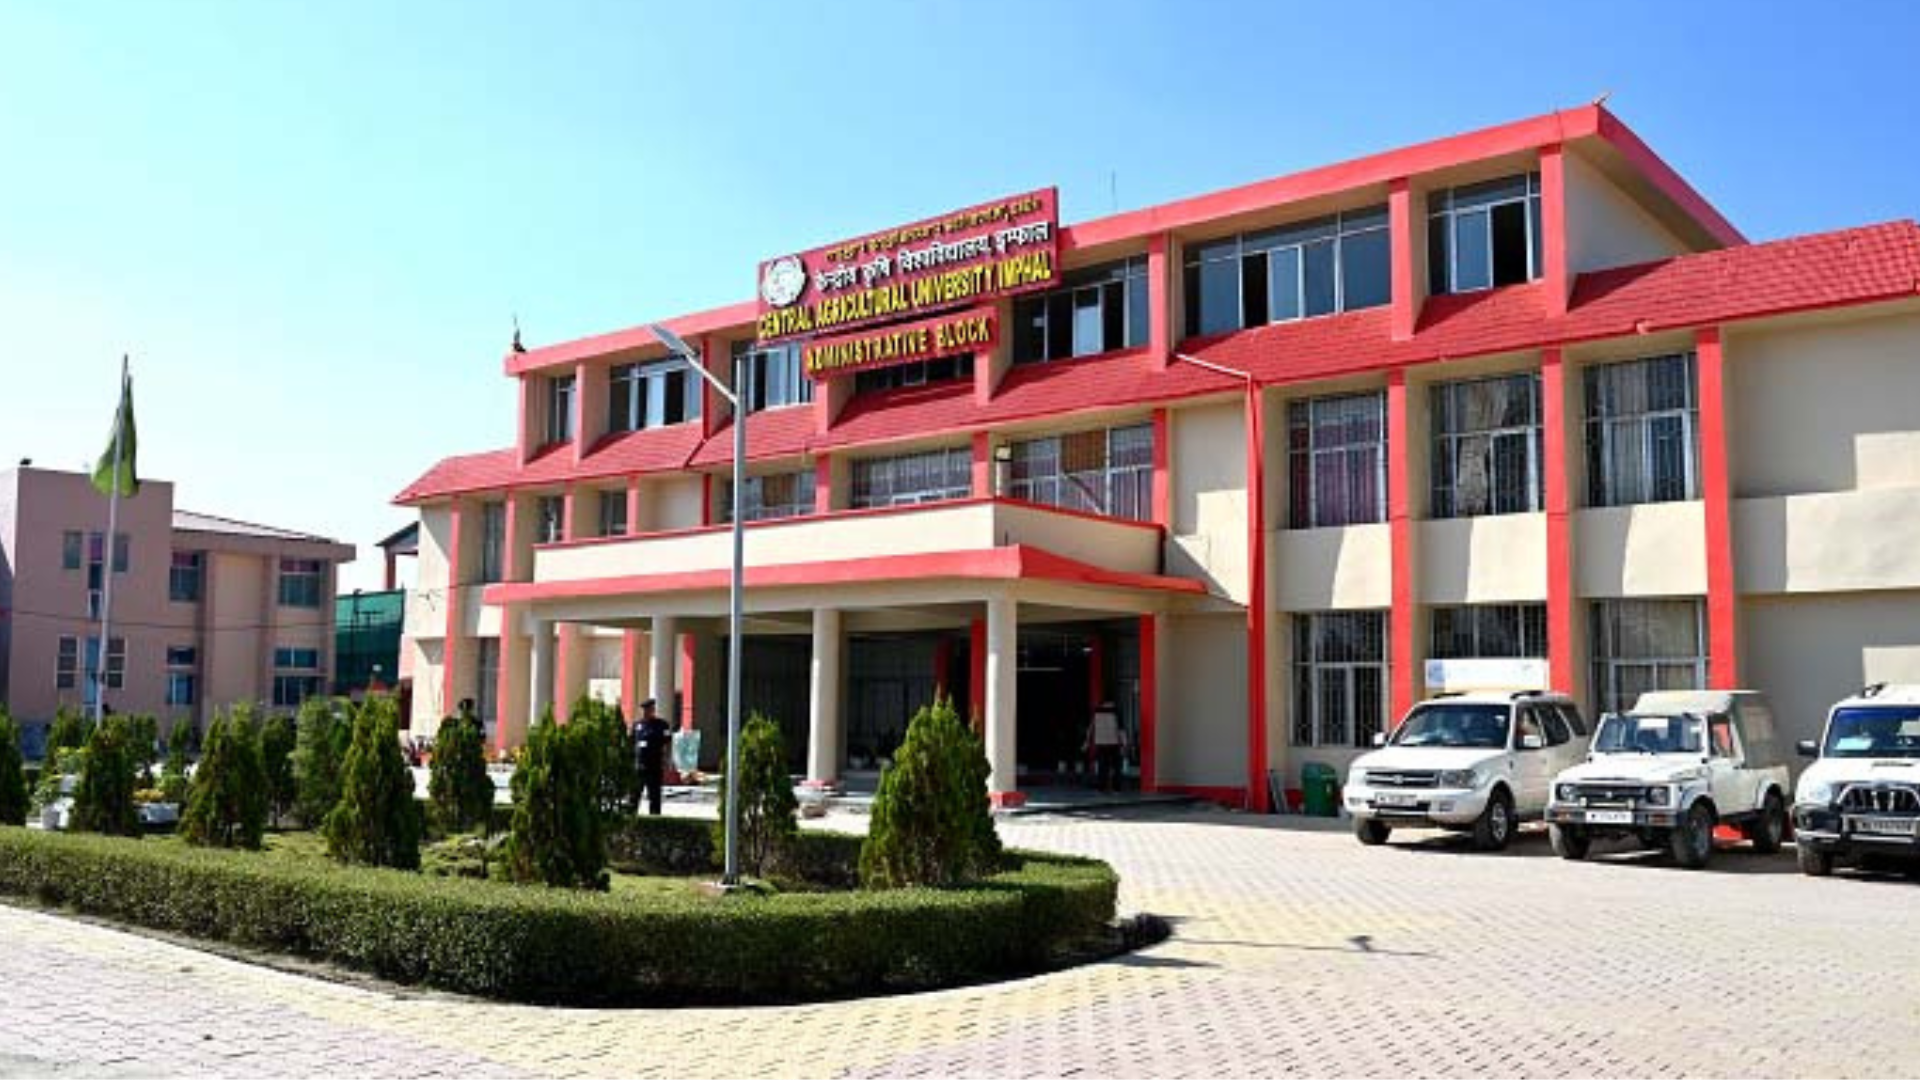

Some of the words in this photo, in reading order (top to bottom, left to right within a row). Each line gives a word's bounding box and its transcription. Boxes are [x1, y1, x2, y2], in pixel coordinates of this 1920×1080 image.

[758, 304, 813, 338] CENTRAL
[816, 281, 907, 327] AGRICULTURAL
[999, 249, 1051, 288] IMPHAL
[806, 327, 927, 370] ADMINISTRATIVE
[935, 316, 990, 347] BLOCK
